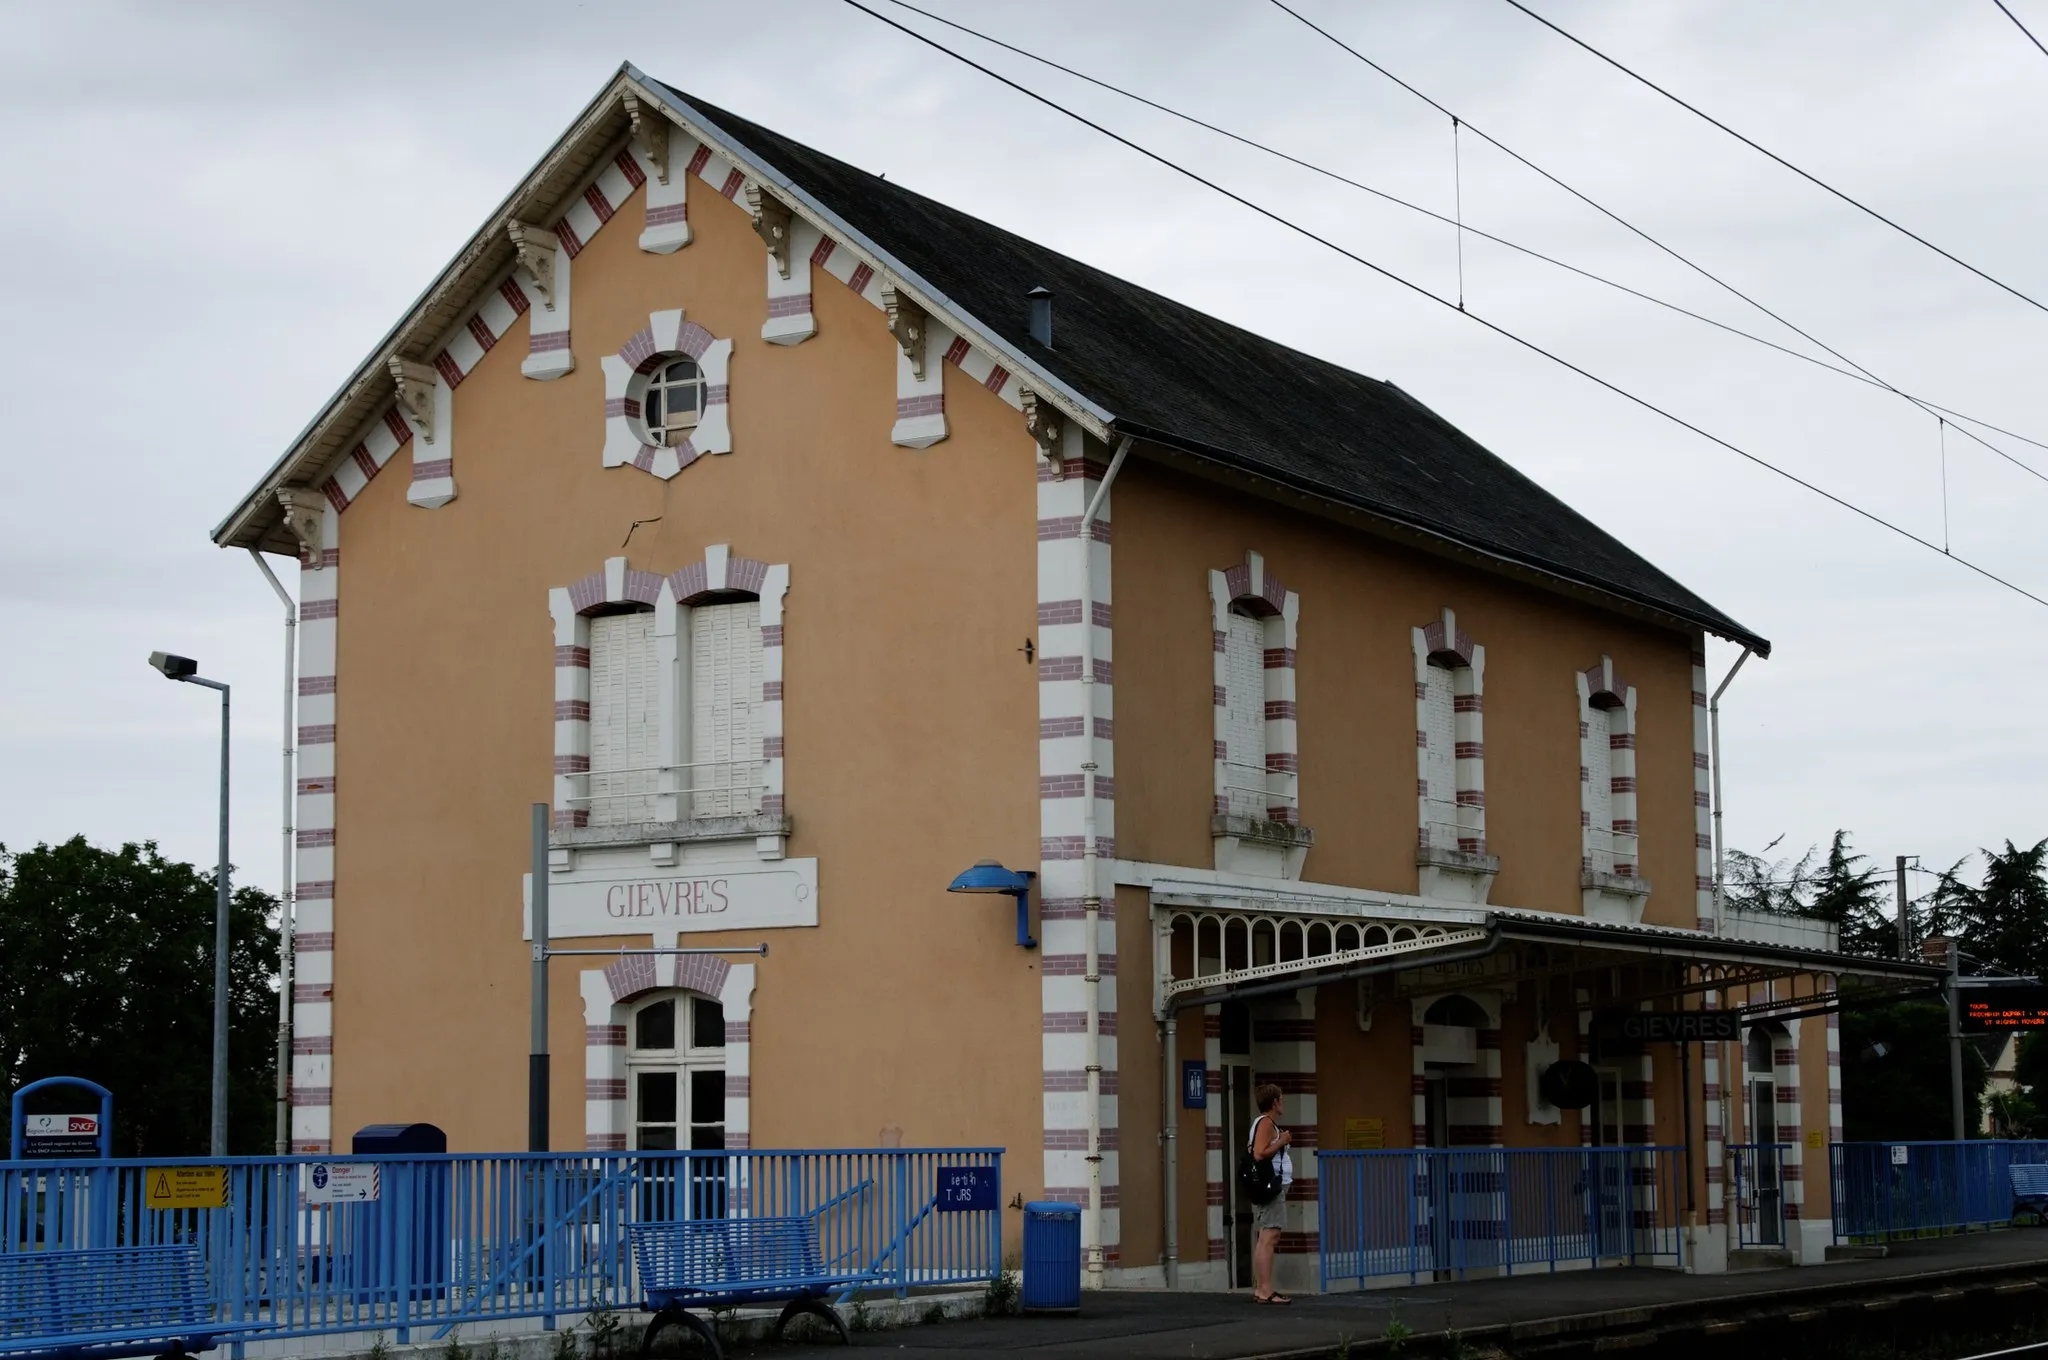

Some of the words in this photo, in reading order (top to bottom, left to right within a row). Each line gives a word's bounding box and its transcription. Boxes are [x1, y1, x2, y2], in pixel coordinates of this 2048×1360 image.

[1623, 1014, 1732, 1039] GIEVRES
[70, 1122, 95, 1131] SNCF
[332, 1166, 351, 1174] Danger
